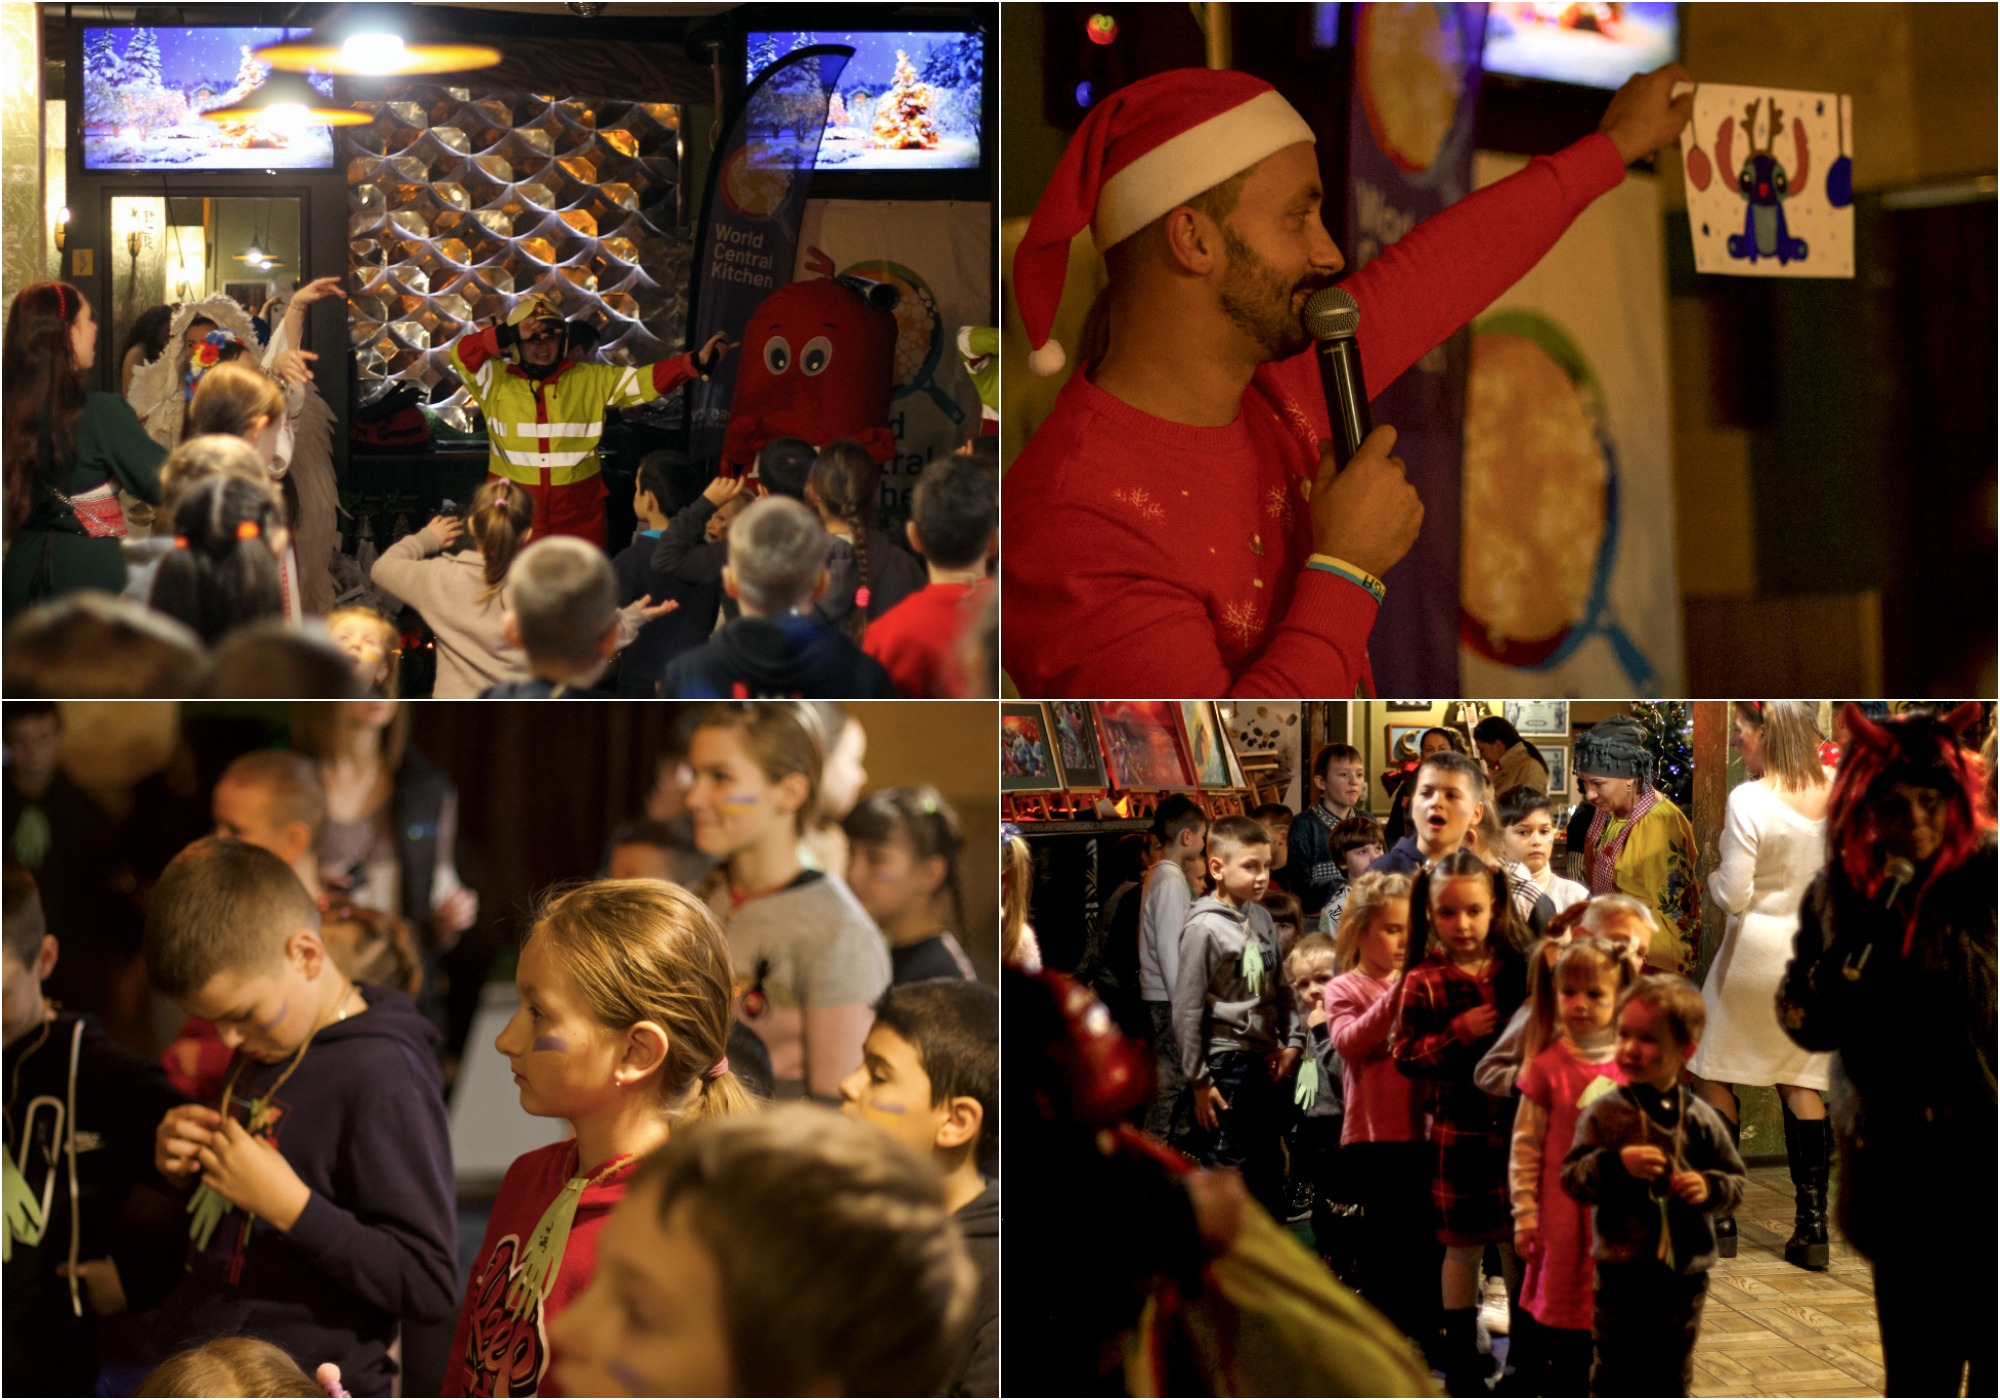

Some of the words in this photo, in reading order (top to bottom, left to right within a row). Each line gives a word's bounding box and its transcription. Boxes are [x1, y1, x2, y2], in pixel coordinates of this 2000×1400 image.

[715, 223, 764, 249] World
[713, 242, 773, 270] Central
[711, 261, 773, 289] Kitchen
